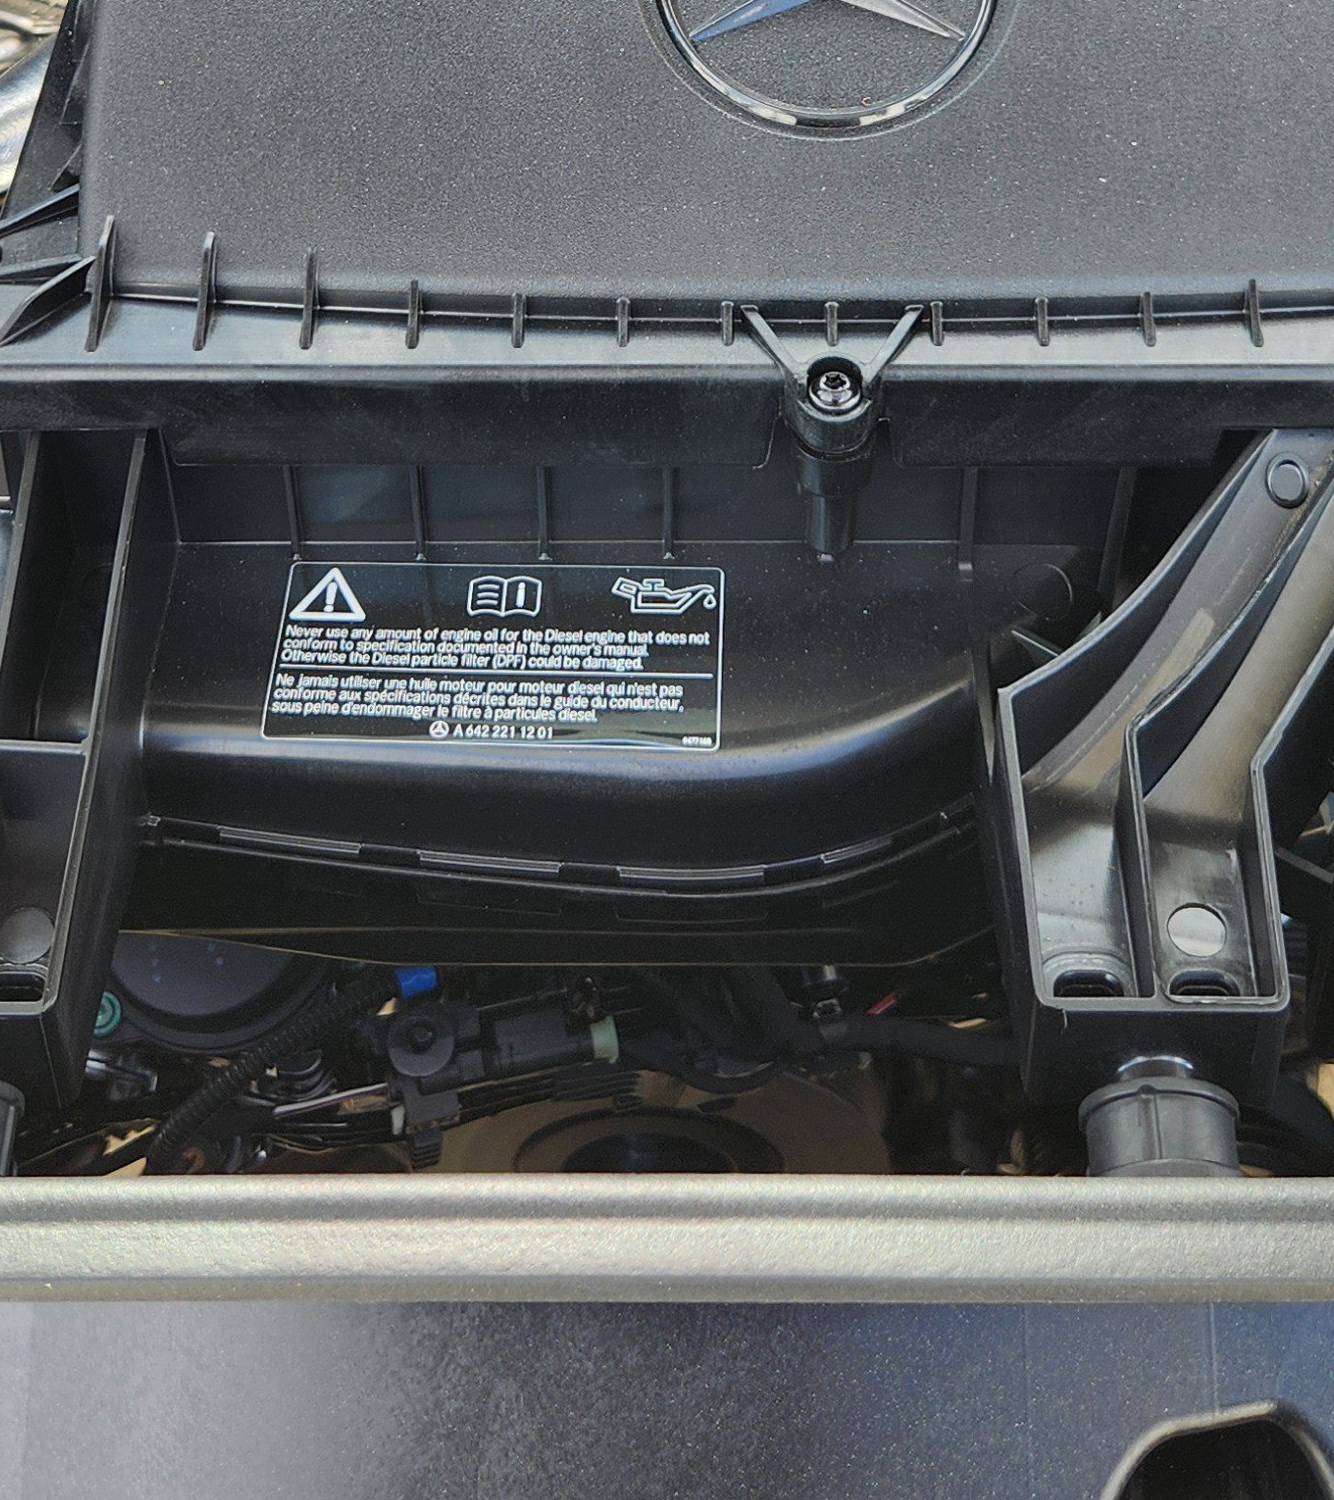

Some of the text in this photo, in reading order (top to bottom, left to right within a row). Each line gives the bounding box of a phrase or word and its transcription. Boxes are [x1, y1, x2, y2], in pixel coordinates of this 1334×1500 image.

[285, 624, 710, 645] Never use any amount of engine oil for the Diesel engine that does not
[275, 673, 683, 698] Ne jamais utiliser une huile moteur pour moteur diesel qui n'est pas
[453, 725, 553, 739] A 642 221 12 01
